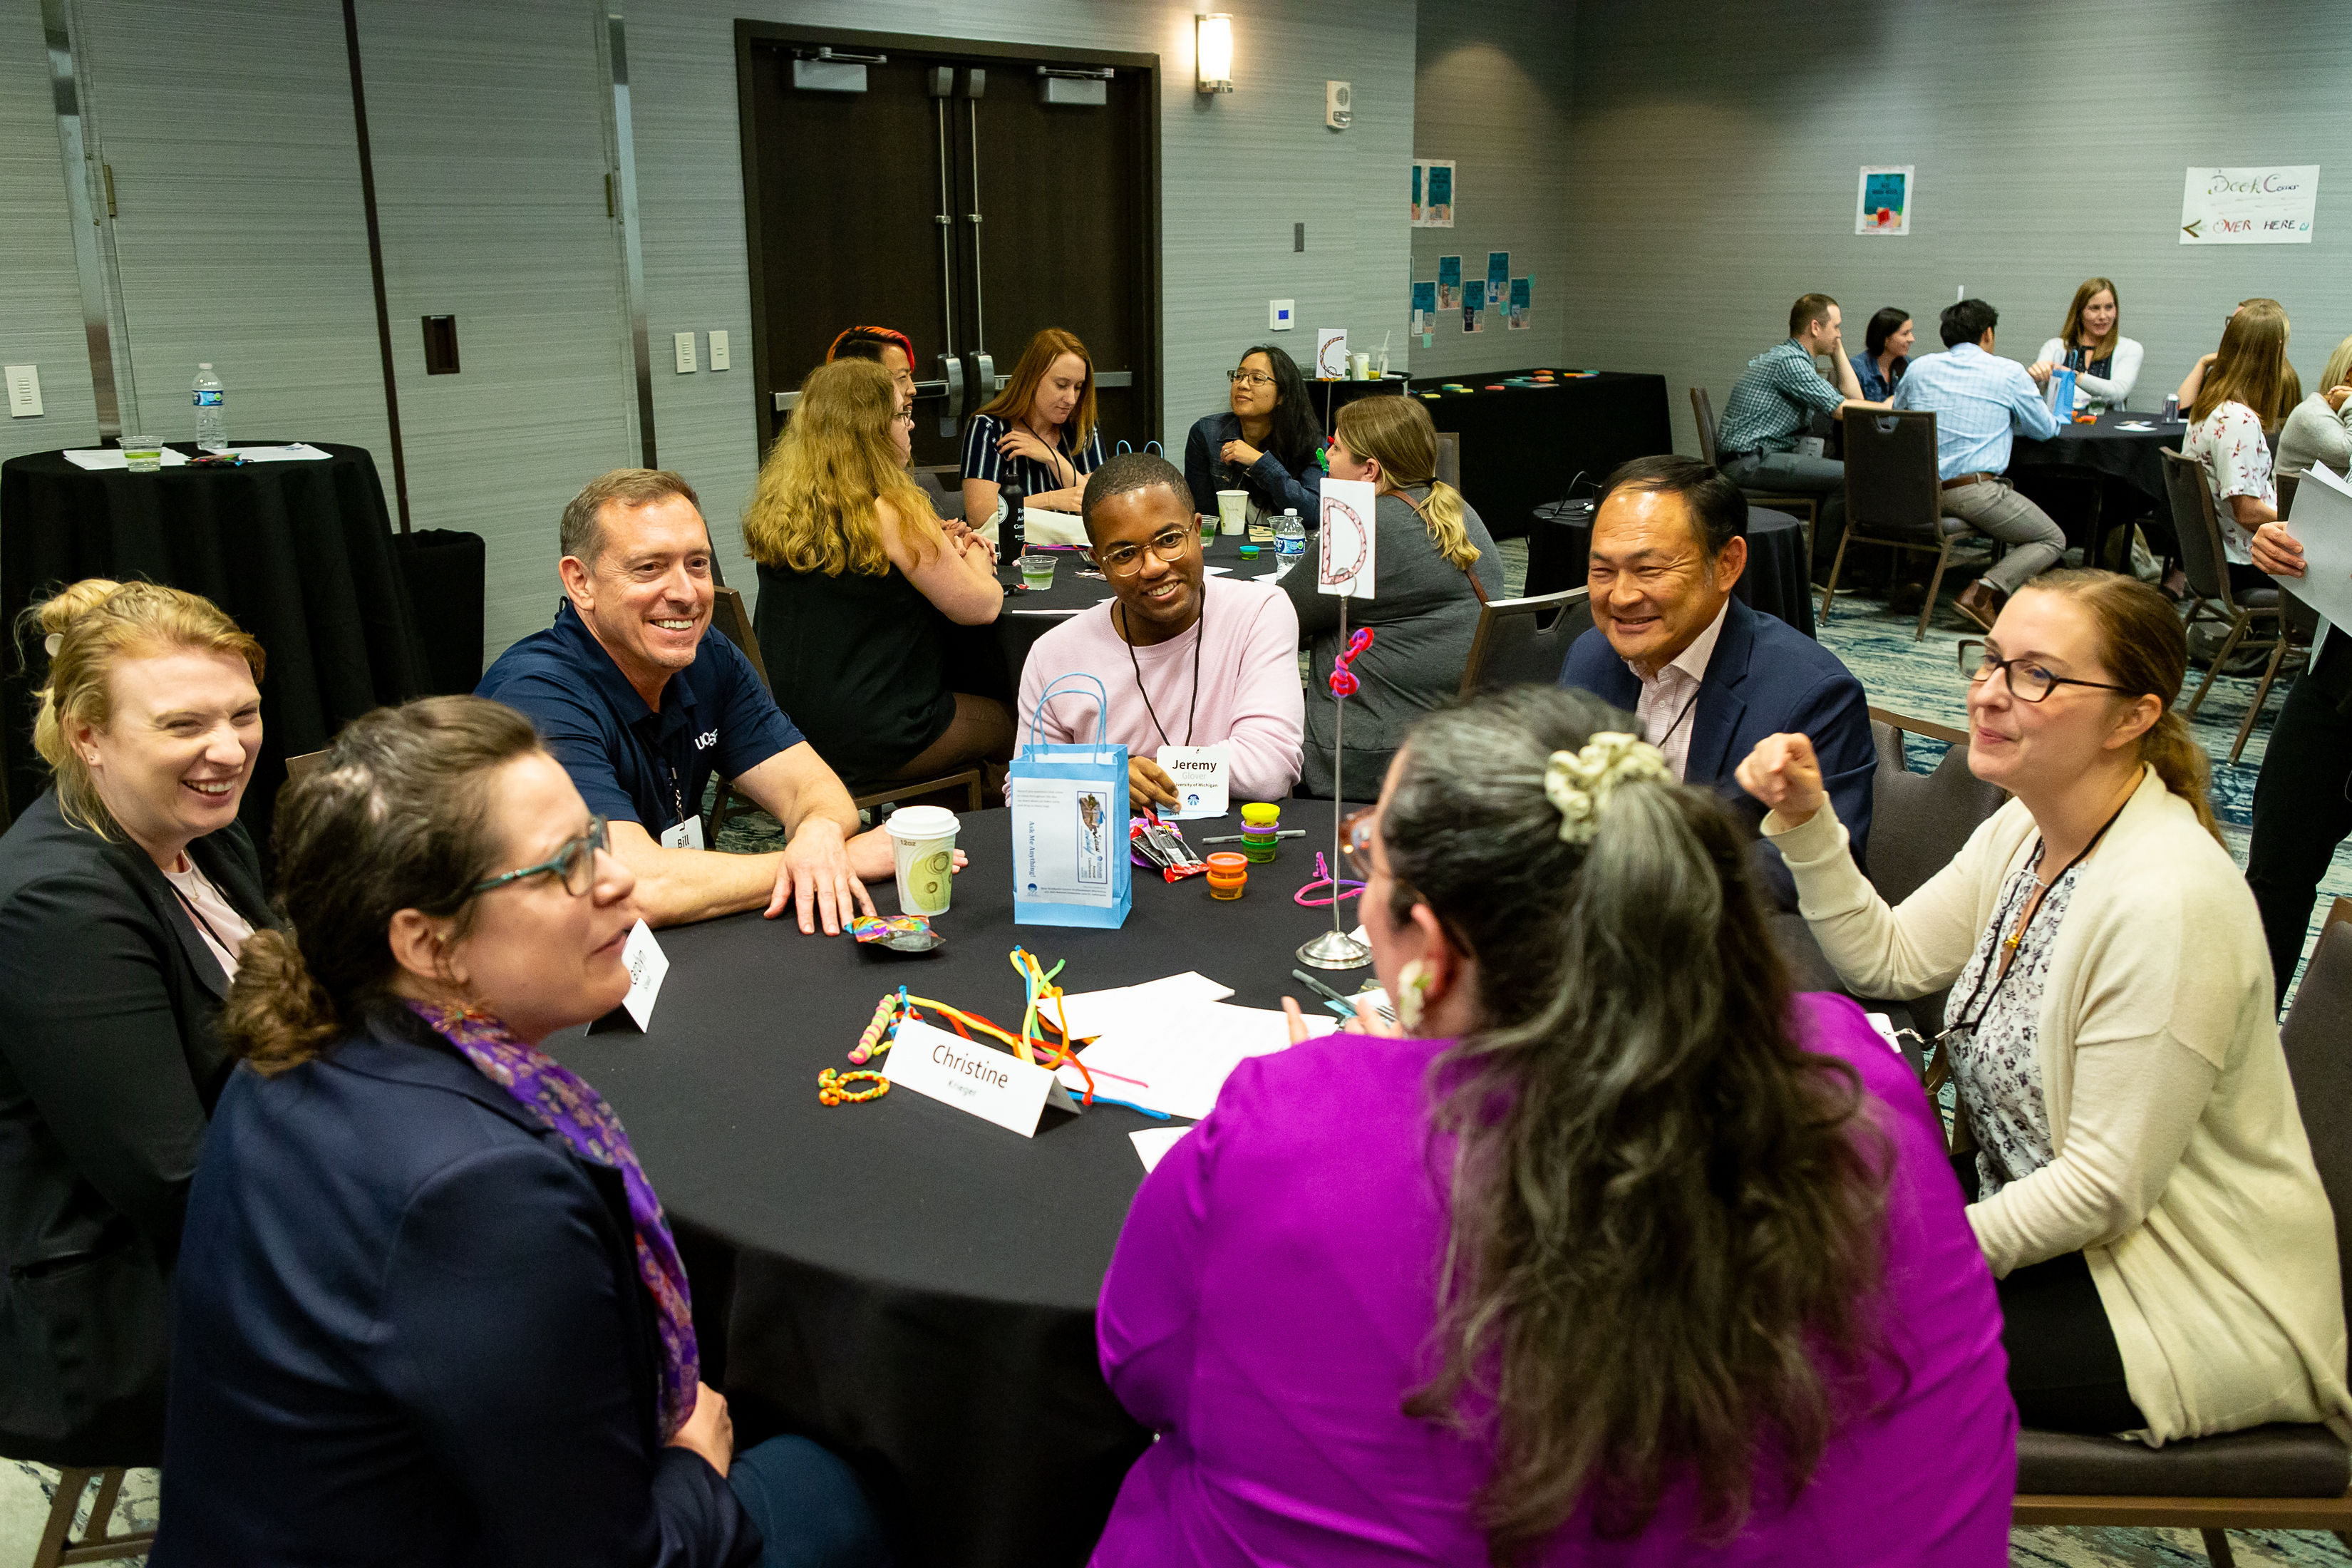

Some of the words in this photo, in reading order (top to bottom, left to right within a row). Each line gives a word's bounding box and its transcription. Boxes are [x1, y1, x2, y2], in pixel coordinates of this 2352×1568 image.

[2207, 173, 2261, 195] Book
[2212, 218, 2252, 234] OVER
[2263, 219, 2295, 230] HERE
[1319, 336, 1344, 377] C
[1321, 497, 1367, 585] D
[694, 728, 718, 750] UCSF
[1172, 760, 1217, 773] Jeremy
[1182, 771, 1207, 780] Glover
[677, 834, 690, 849] Bill
[1028, 835, 1036, 845] Me
[1028, 846, 1036, 877] Anything!
[933, 1045, 1009, 1089] Christine
